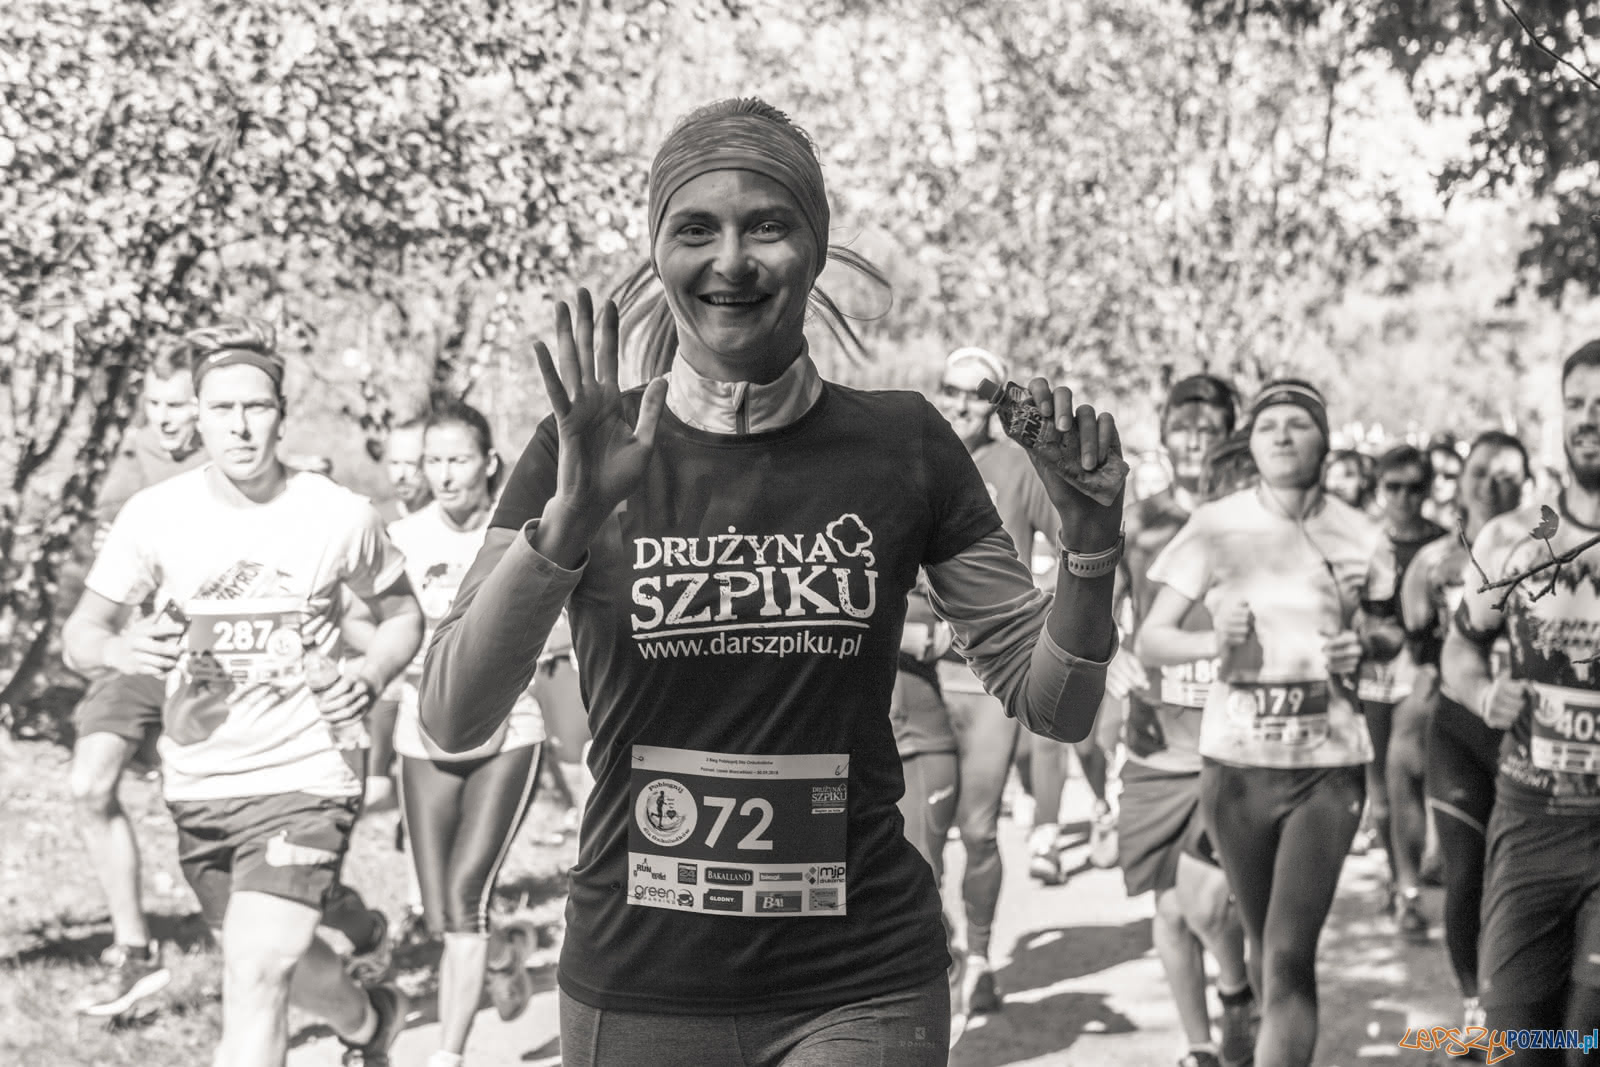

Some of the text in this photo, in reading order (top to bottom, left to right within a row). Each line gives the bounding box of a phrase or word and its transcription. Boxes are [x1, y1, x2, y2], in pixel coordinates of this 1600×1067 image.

[633, 525, 838, 570] DRUŻYNA
[631, 565, 879, 631] SZPIKU
[213, 620, 274, 651] 287
[638, 630, 862, 660] www.darszpiku.pl
[1254, 687, 1305, 715] 179
[811, 791, 848, 802] SZPIKU
[703, 795, 774, 851] 72
[708, 870, 751, 882] BAKALLAND
[820, 865, 845, 878] mjp
[634, 885, 676, 900] green
